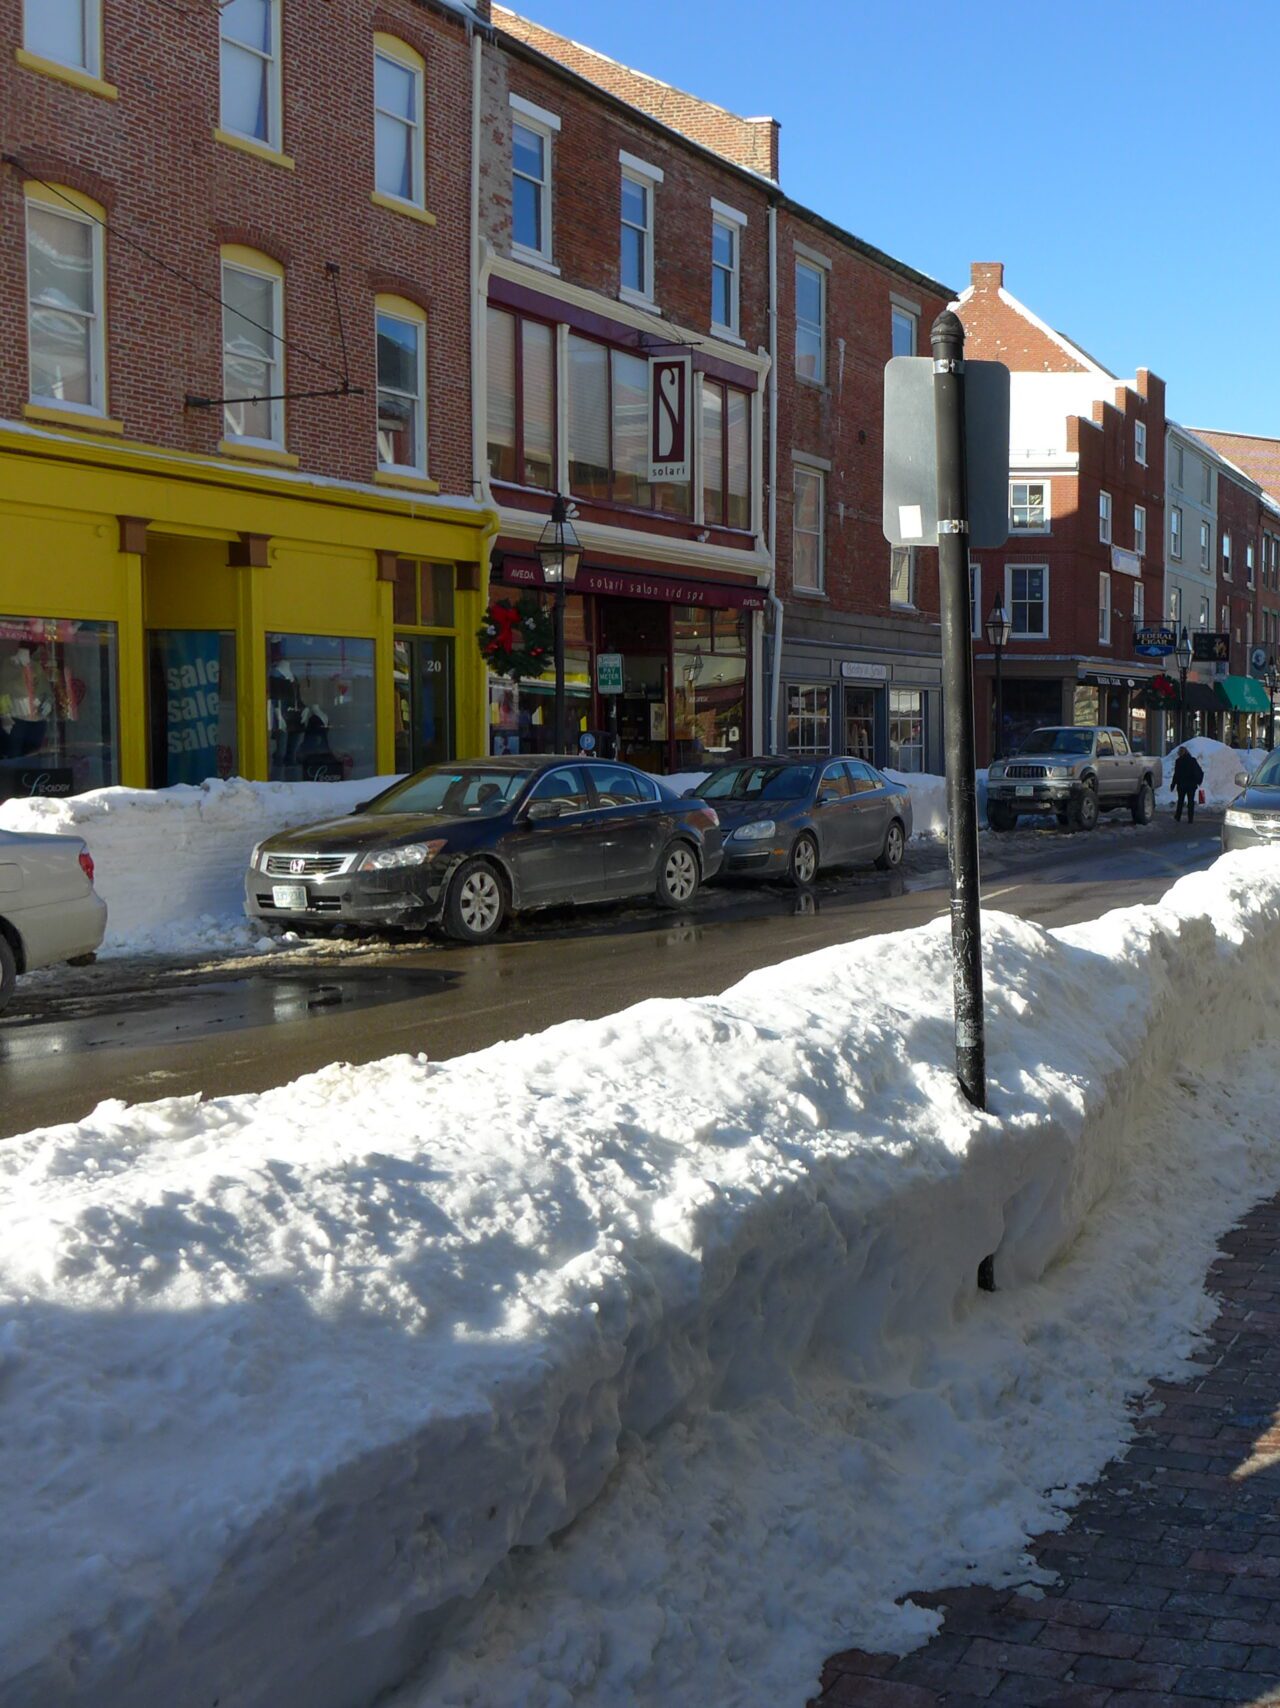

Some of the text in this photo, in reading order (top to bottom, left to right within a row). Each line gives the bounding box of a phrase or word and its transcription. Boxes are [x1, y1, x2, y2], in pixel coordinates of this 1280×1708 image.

[652, 465, 686, 477] solari
[511, 568, 536, 580] AVEDA
[590, 578, 623, 591] solari
[630, 582, 658, 595] salon
[687, 590, 704, 601] spa
[1135, 632, 1173, 641] FEDERAL
[167, 658, 219, 690] sale
[427, 660, 442, 672] 20
[167, 690, 219, 722] sale
[167, 721, 218, 753] sale
